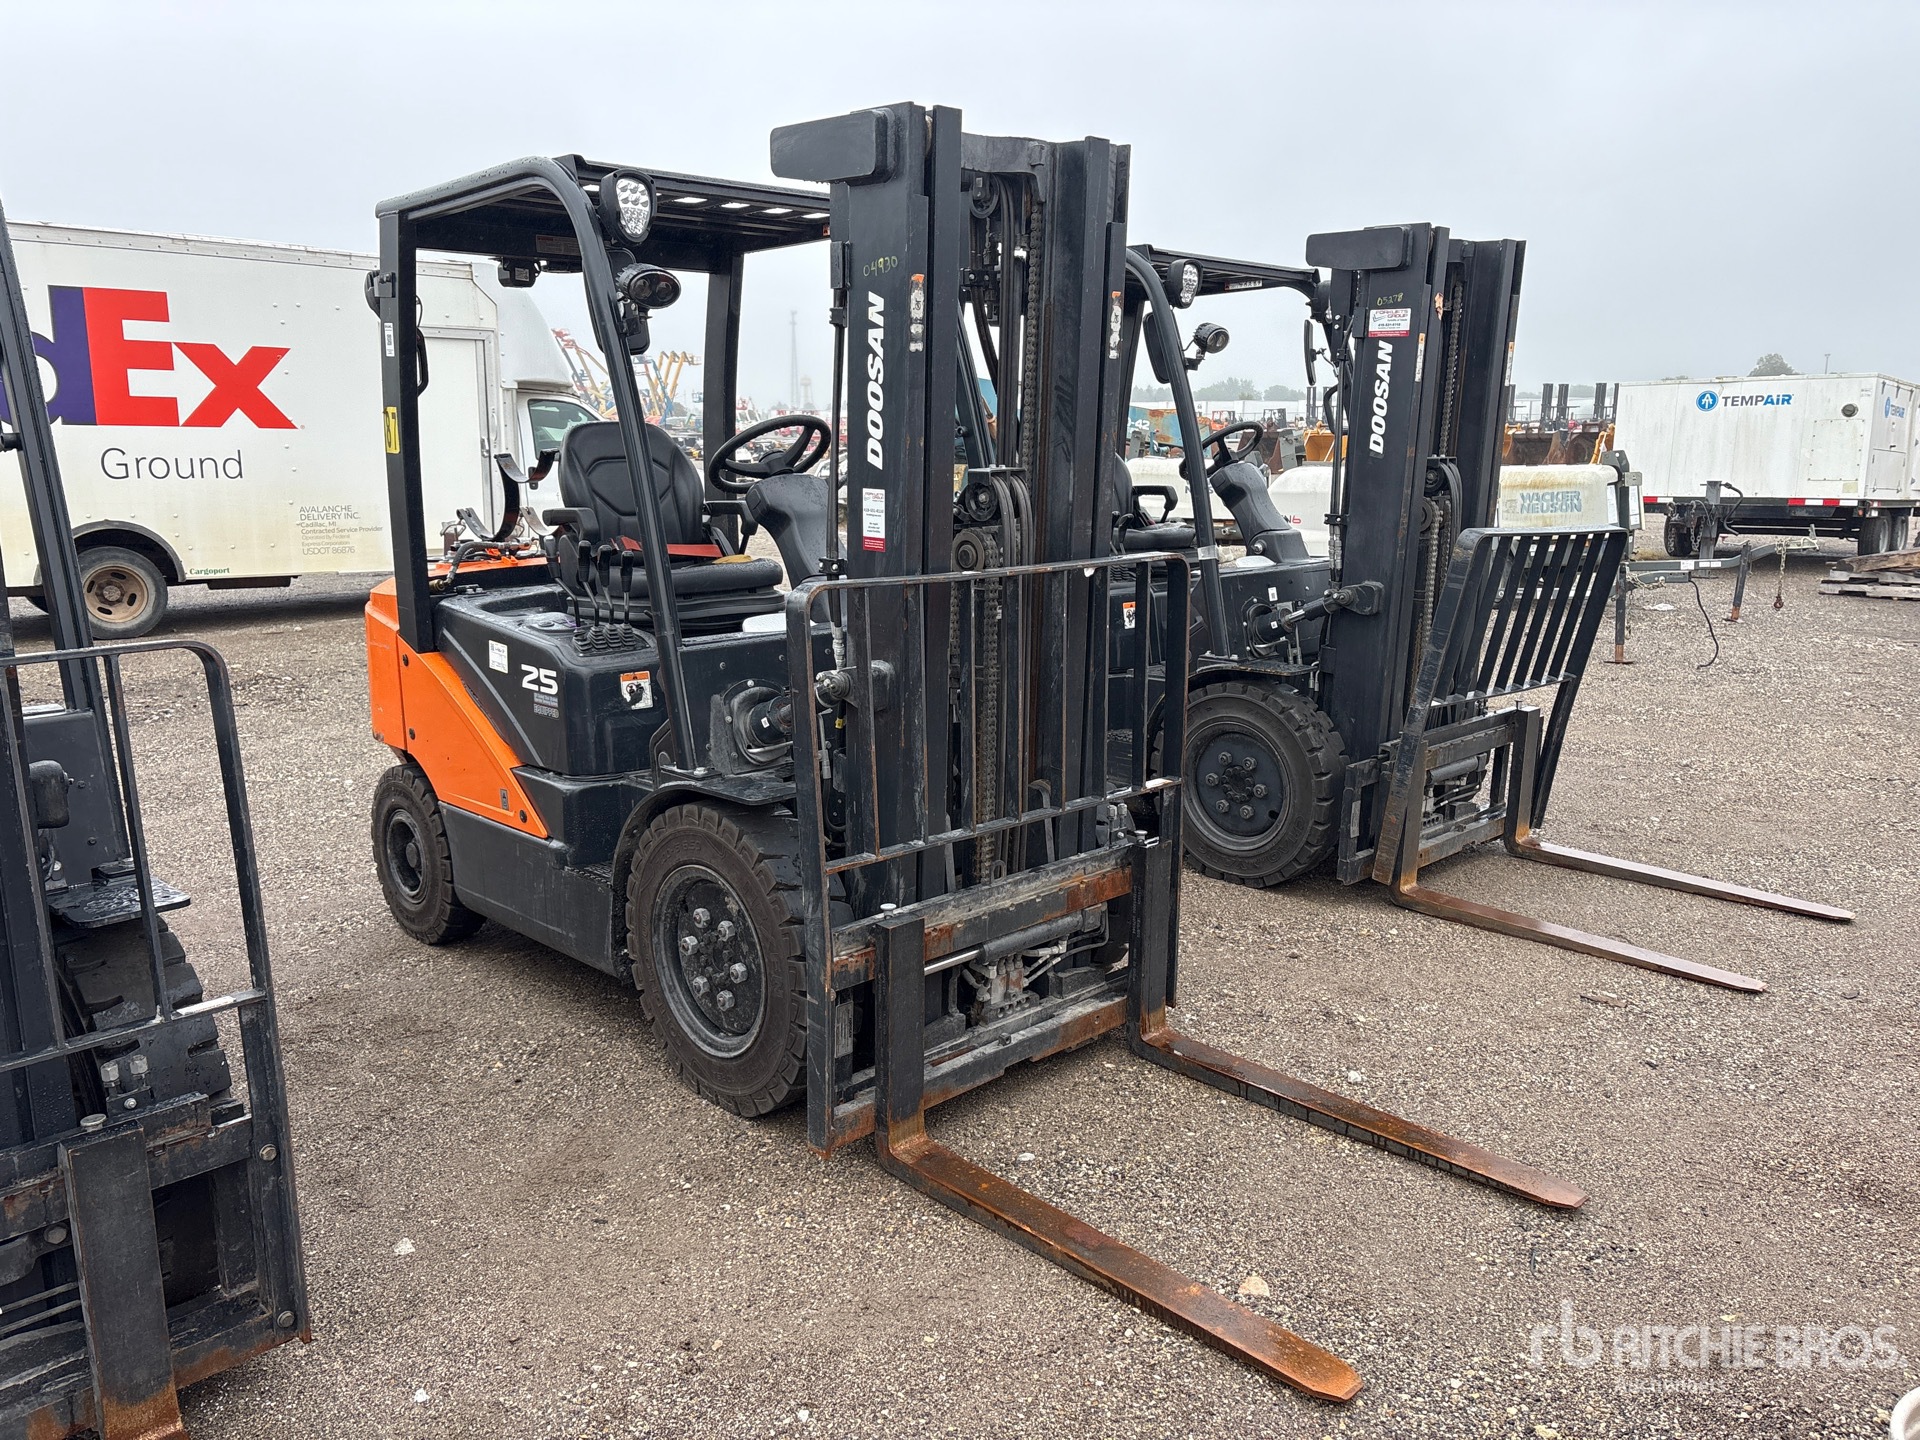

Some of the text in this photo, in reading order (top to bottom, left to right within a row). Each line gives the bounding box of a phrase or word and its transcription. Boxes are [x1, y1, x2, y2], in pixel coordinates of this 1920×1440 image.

[863, 255, 898, 277] 04930
[867, 291, 885, 470] DOOSAN
[1369, 340, 1393, 454] DOOSAN
[100, 447, 243, 479] Ground
[1520, 490, 1580, 503] WACKER
[299, 505, 352, 513] AVALANCHE
[1521, 501, 1582, 514] NEUSON
[300, 513, 342, 521] DELIVERY
[302, 547, 331, 556] USDOT
[520, 663, 559, 695] 25
